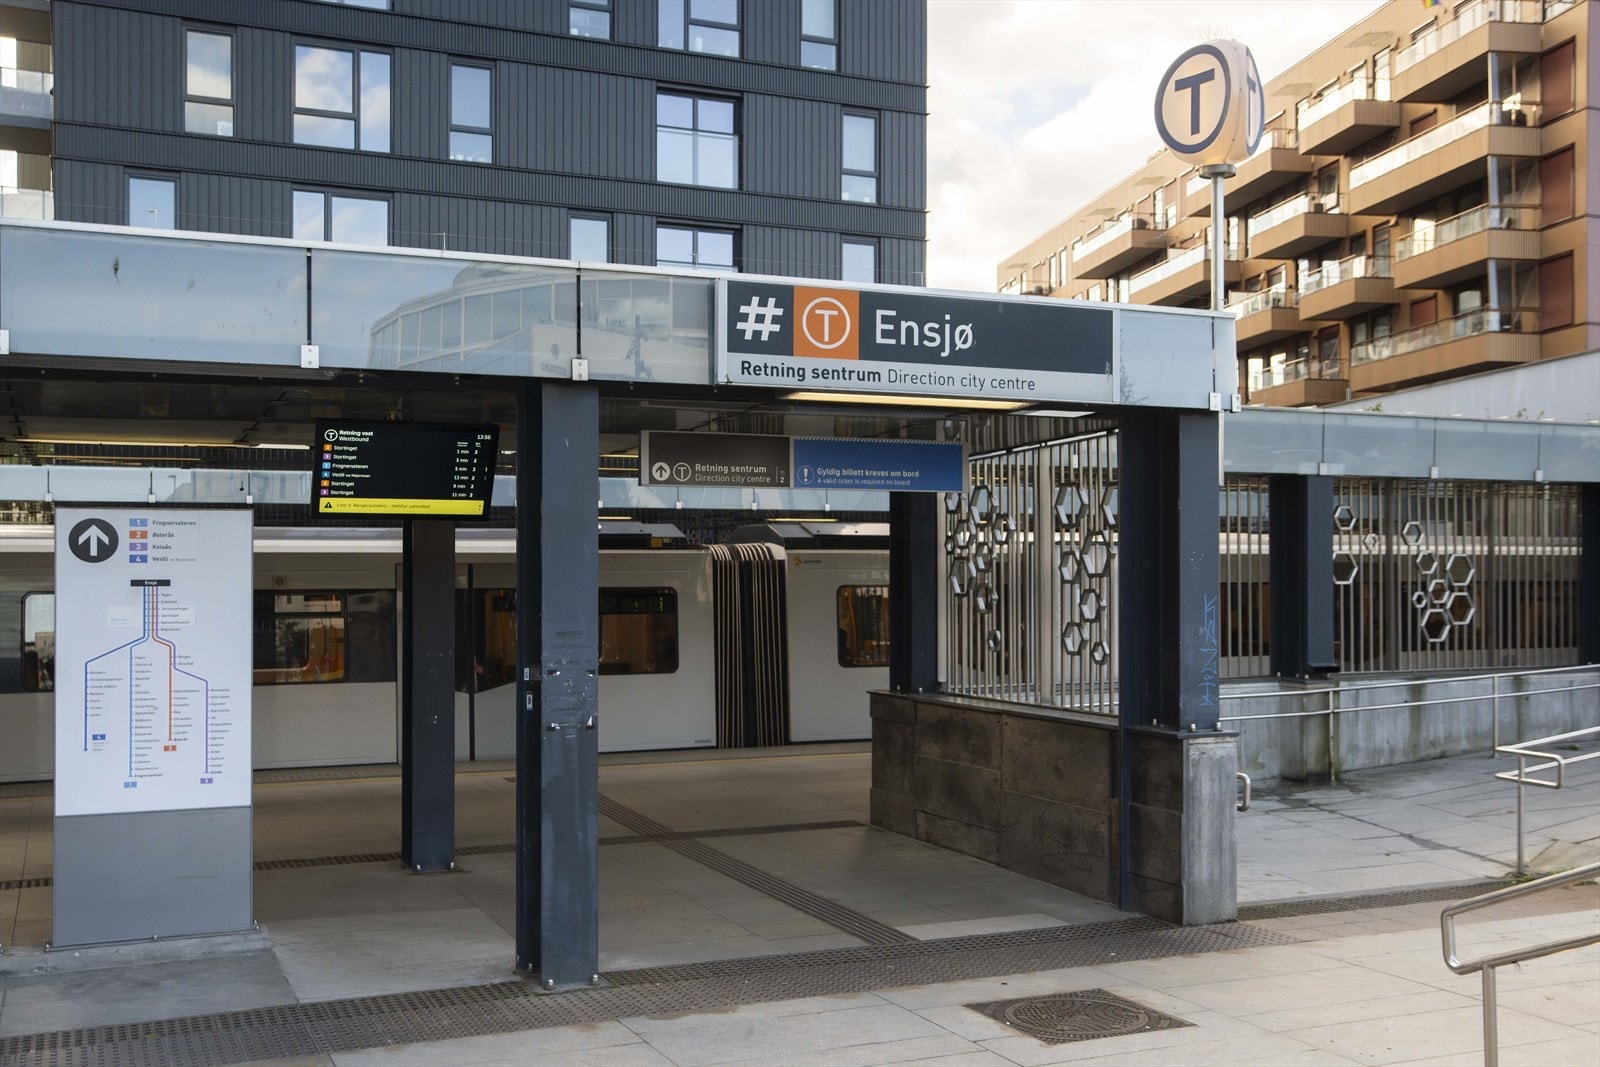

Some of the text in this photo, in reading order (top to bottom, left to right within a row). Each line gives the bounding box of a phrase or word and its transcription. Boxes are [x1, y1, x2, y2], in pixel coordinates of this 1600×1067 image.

[1174, 68, 1214, 136] T
[876, 309, 973, 358] Ensjø
[741, 360, 1035, 392] Retning sentrum Direction city centre
[695, 464, 766, 474] Retning sentrum
[732, 474, 746, 484] city
[817, 468, 840, 476] Gyldig
